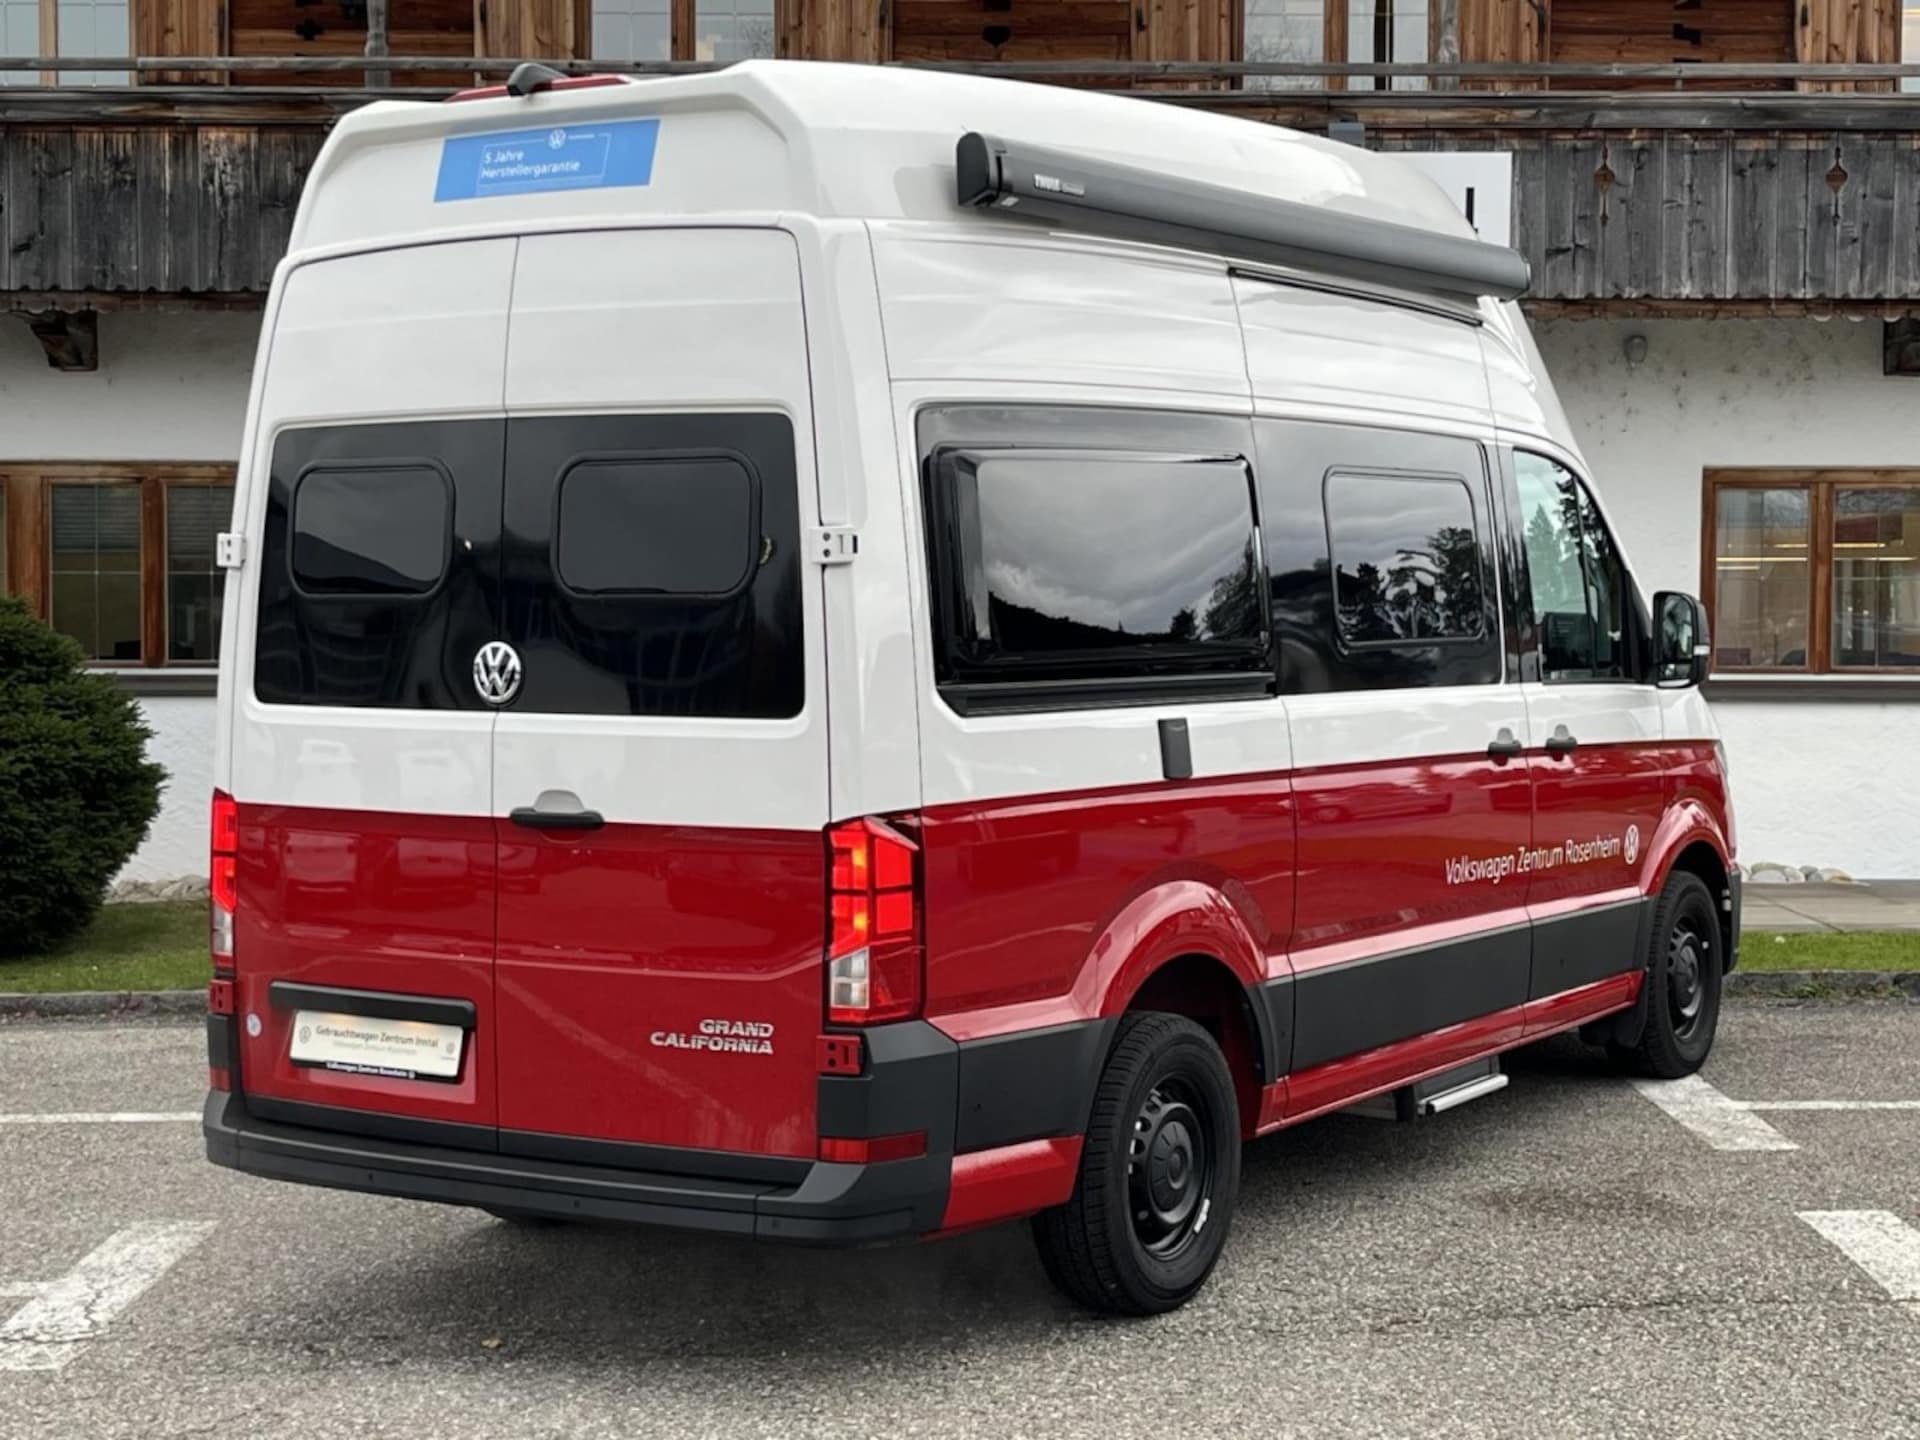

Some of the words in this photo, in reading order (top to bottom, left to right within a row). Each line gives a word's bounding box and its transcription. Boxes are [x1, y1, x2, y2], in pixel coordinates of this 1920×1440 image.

[485, 152, 492, 164] 5
[494, 150, 525, 163] Jahre
[481, 160, 581, 178] Herstellergarantie
[473, 641, 521, 703] VW
[1445, 854, 1515, 885] Volkswagen
[1517, 846, 1563, 873] Zentrum
[1566, 834, 1621, 864] Rosenheim
[315, 1025, 379, 1042] Gebrauchtwagen
[379, 1031, 415, 1045] Zentrum
[699, 1018, 775, 1038] GRAND
